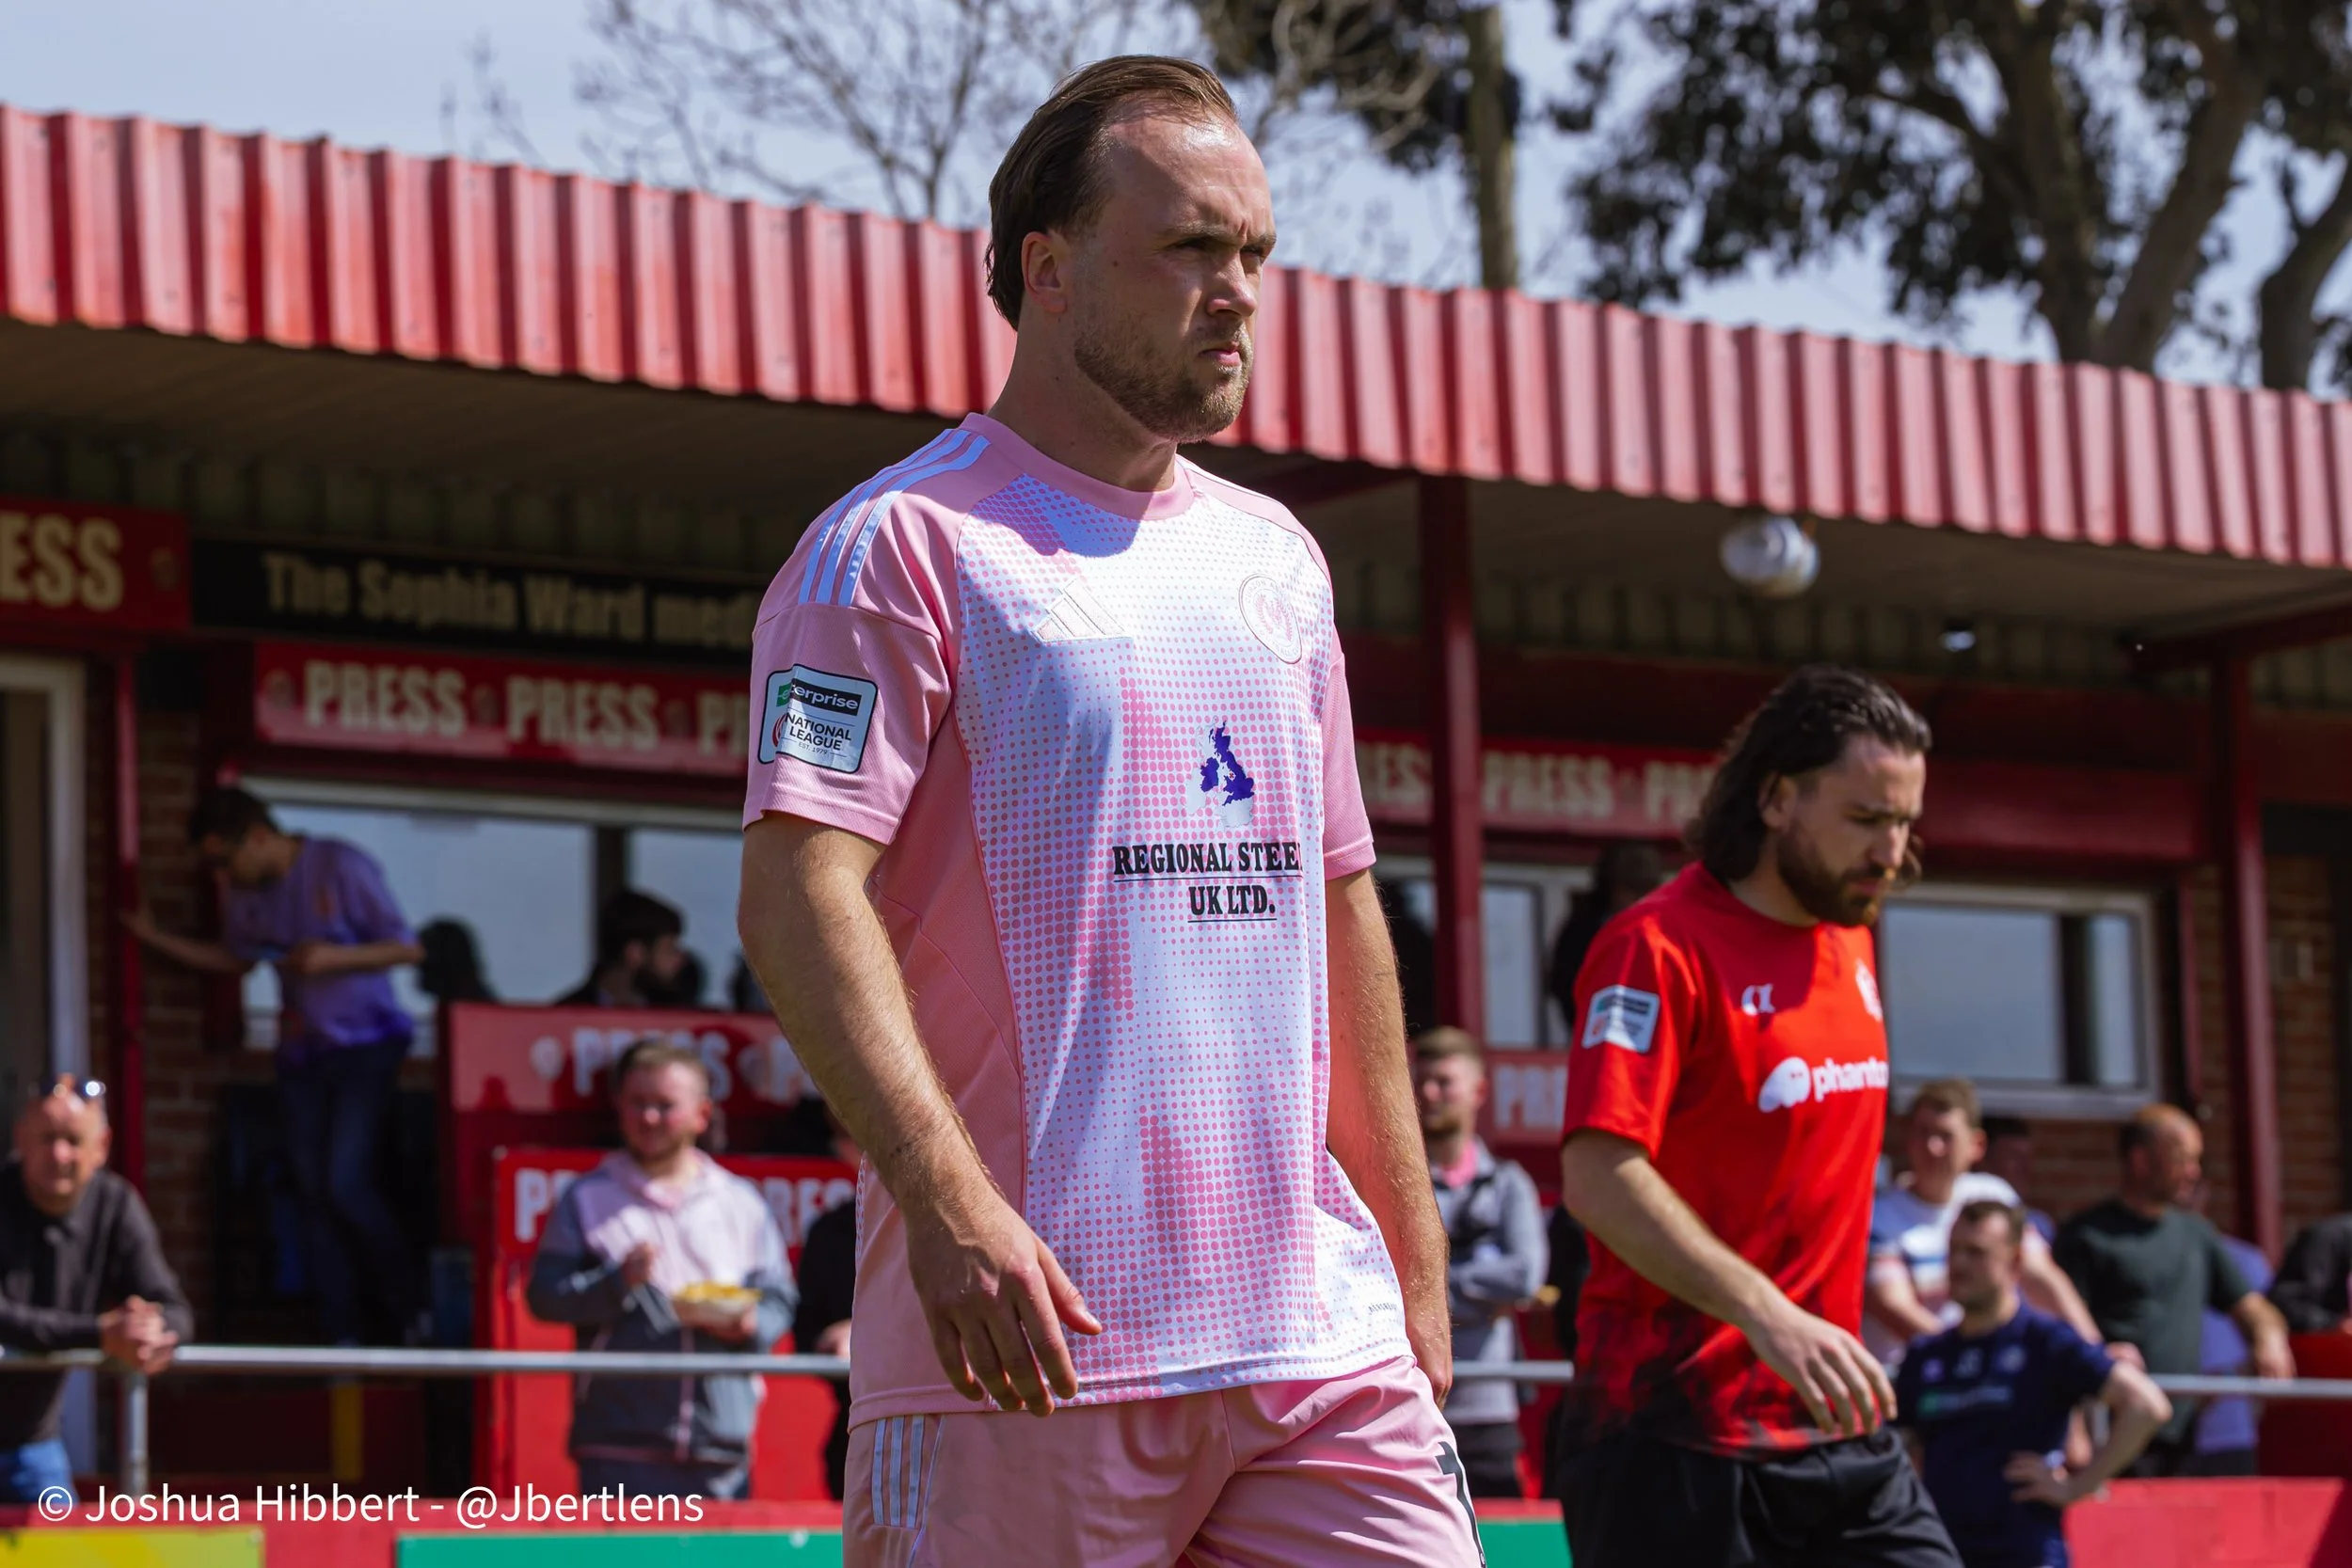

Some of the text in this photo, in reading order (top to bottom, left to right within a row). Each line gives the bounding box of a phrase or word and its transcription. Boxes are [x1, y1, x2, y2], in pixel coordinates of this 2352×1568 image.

[263, 553, 349, 615] The
[358, 560, 516, 630] Sophia
[523, 575, 644, 641] Ward
[303, 661, 467, 736] PRESS
[505, 675, 659, 751] PRESS
[785, 712, 851, 741] NATIONAL
[789, 726, 843, 751] LEAGUE
[1483, 751, 1614, 817] PRESS
[1112, 842, 1303, 875] REGIONAL STEE
[1188, 885, 1276, 915] UK LTD.
